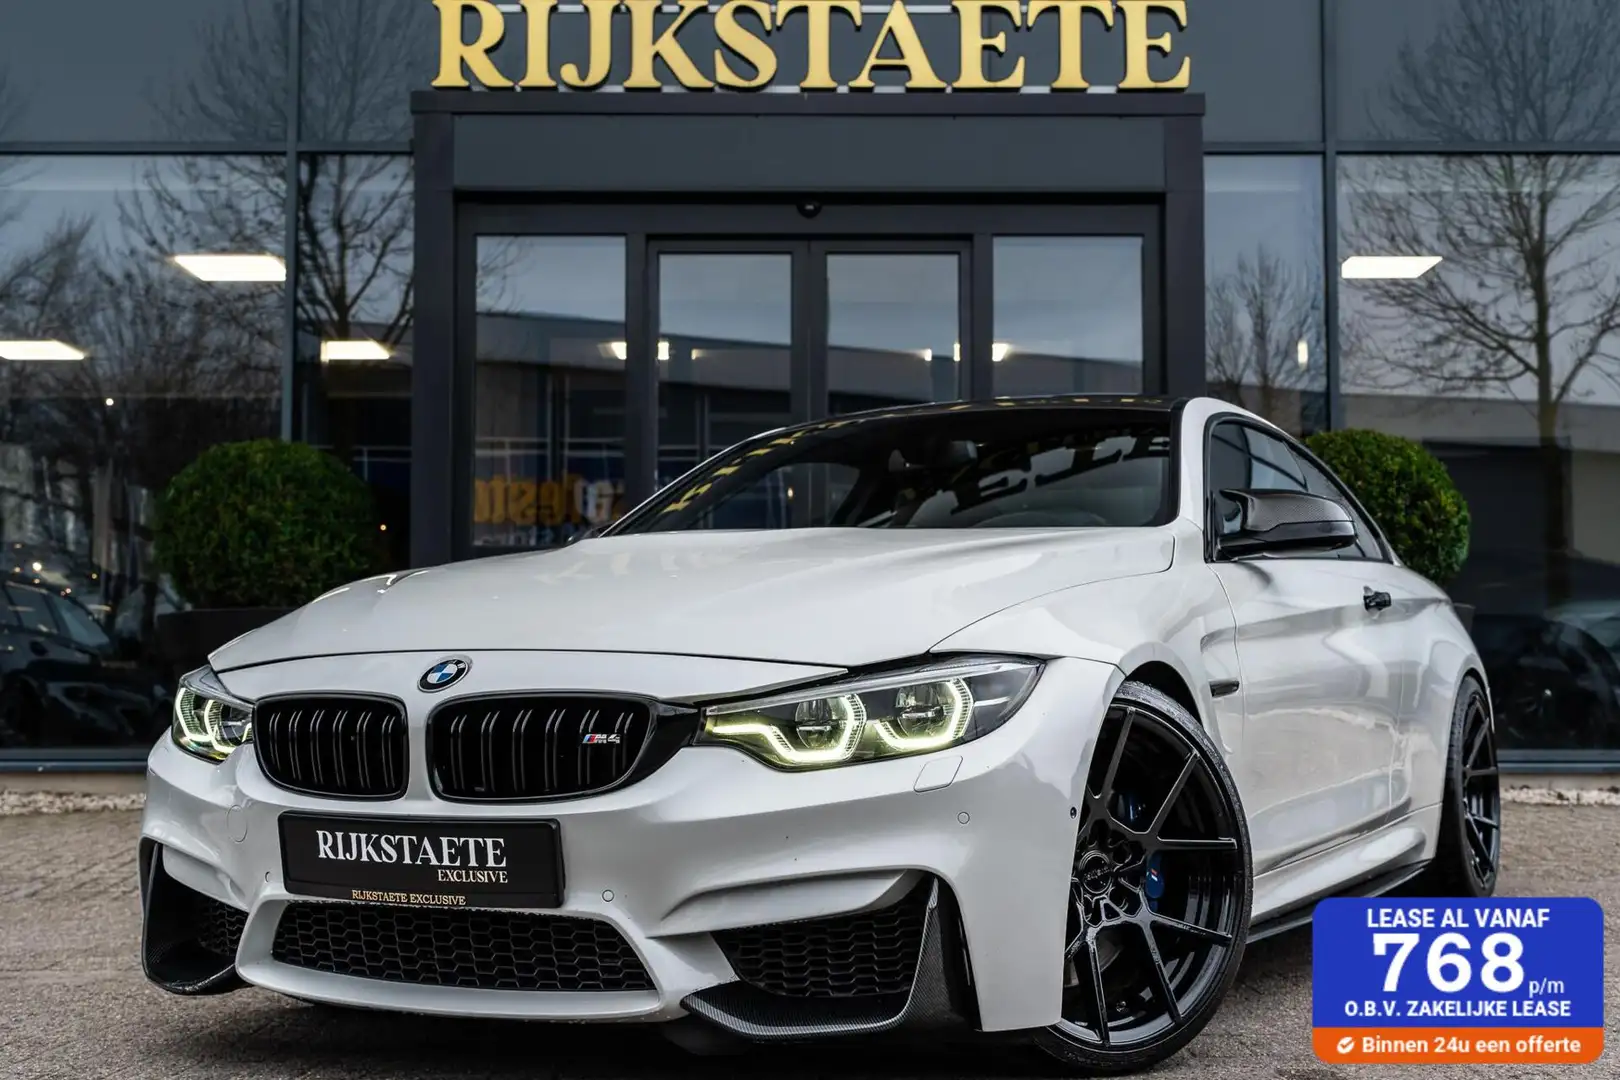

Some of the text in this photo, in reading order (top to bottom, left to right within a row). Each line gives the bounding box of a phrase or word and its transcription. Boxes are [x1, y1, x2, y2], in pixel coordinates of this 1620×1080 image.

[431, 0, 1191, 90] RIJKSTAETE
[594, 733, 621, 744] M4
[316, 830, 507, 867] RIJKSTAETE
[437, 869, 508, 884] EXCLUSIVE
[352, 890, 466, 906] RIJKSTAETE EXCLUSIVE
